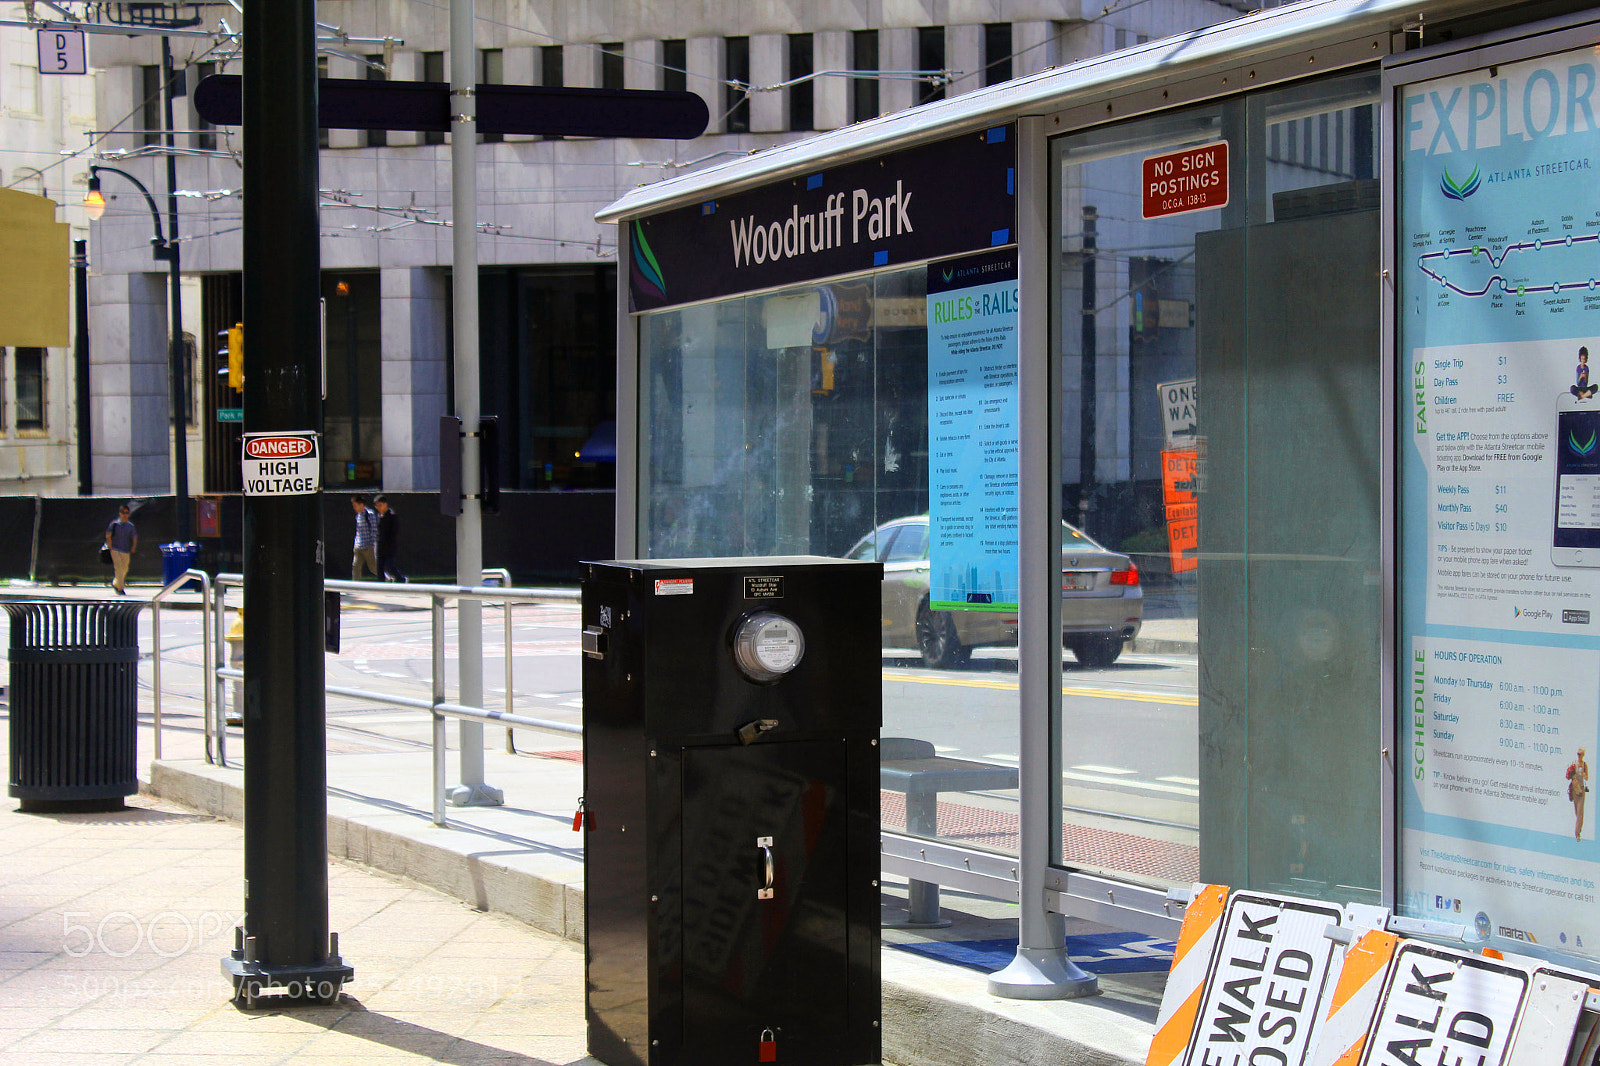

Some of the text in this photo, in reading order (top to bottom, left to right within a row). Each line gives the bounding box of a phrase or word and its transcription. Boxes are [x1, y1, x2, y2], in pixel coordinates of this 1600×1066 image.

[56, 34, 66, 50] D
[57, 52, 68, 70] 5
[1405, 63, 1600, 156] EXPLOR
[1155, 151, 1215, 177] NO SIGN
[1150, 170, 1219, 197] POSTINGS
[1488, 168, 1531, 183] ATLANTA
[730, 179, 913, 268] Woodruff Park
[957, 261, 1010, 277] ATLANTA STREETCAR
[935, 288, 1018, 324] RULES RAILS
[1435, 356, 1506, 370] Single Trip $1
[1434, 375, 1507, 388] Day Pass $3
[1168, 385, 1196, 404] ONE
[1415, 361, 1427, 434] FARES
[1434, 393, 1515, 405] Children FREE
[1436, 433, 1445, 441] Get
[1457, 432, 1469, 440] APP!
[1511, 433, 1530, 441] options
[252, 441, 306, 454] DANGER
[1522, 453, 1542, 462] Google
[259, 462, 298, 475] HIGH
[248, 478, 312, 492] VOLTAGE
[1438, 485, 1506, 495] Weekly Pass $11
[1438, 504, 1507, 513] Monthly Pass $40
[1173, 526, 1195, 540] DET
[1438, 521, 1455, 530] Visitor
[1457, 522, 1468, 530] Pass
[1496, 522, 1507, 531] $10
[1523, 609, 1553, 620] Google Play
[1435, 651, 1502, 664] HOURS OF OPERATION
[1434, 676, 1458, 687] Monday
[1467, 678, 1493, 690] Thursday
[1500, 682, 1512, 691] 6:00
[1533, 686, 1548, 696] 11:00
[1551, 688, 1564, 697] p.m.
[1434, 693, 1451, 705] Friday
[1500, 701, 1512, 710] 6:00
[1534, 705, 1546, 714] 1:00
[1413, 649, 1425, 782] SCHEDULE
[1433, 711, 1459, 724] Saturday
[1534, 724, 1546, 733] 1:00
[1433, 729, 1454, 741] Sunday
[1500, 738, 1513, 748] 9:00
[1534, 743, 1548, 752] 11:00
[1450, 784, 1464, 792] phone
[1483, 788, 1499, 798] Atlanta
[1501, 791, 1520, 800] Streetcar
[1522, 795, 1537, 803] mobile
[1457, 775, 1471, 784] before
[1535, 786, 1560, 796] information
[1420, 848, 1430, 856] Visit
[1519, 868, 1534, 878] safety
[1537, 871, 1569, 884] information
[1570, 877, 1581, 885] and
[1458, 870, 1479, 881] packages
[1486, 876, 1505, 886] activities
[1522, 882, 1543, 893] Streetcar
[1545, 887, 1567, 897] operator
[1575, 892, 1583, 901] call
[1499, 926, 1523, 940] marta
